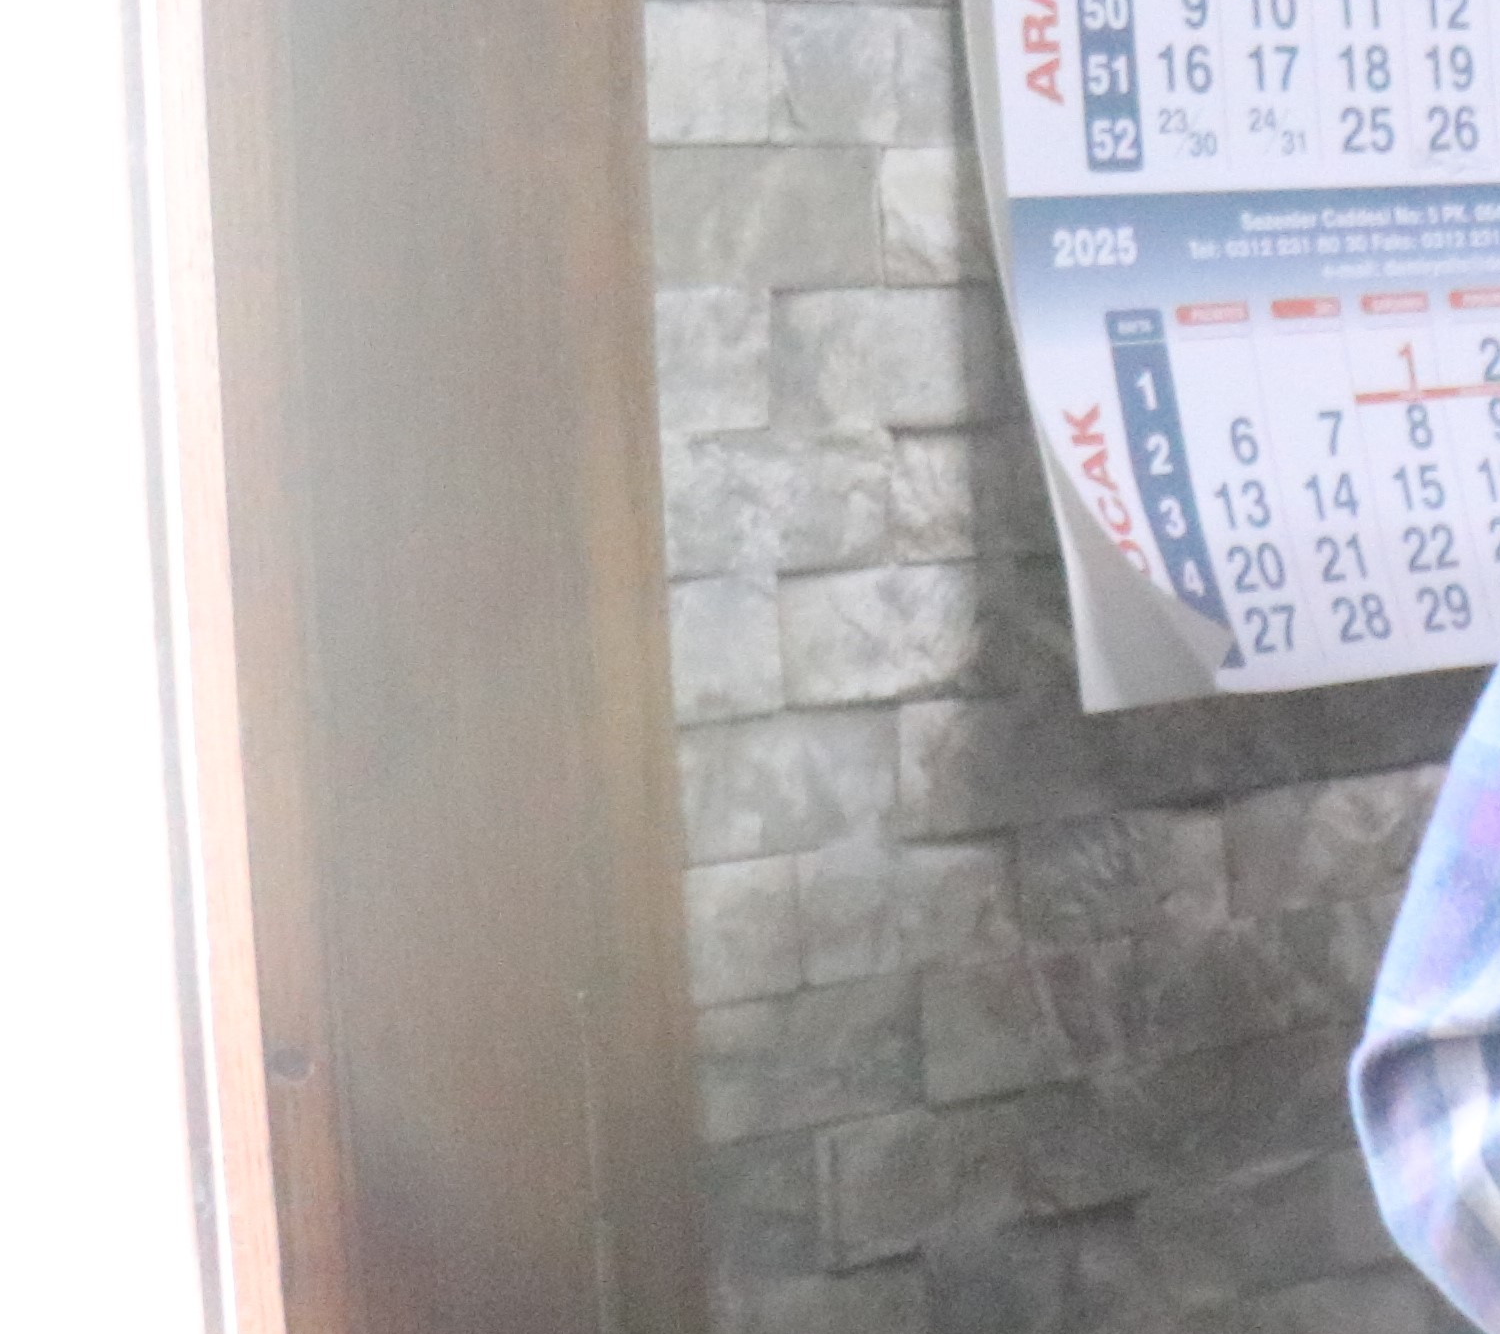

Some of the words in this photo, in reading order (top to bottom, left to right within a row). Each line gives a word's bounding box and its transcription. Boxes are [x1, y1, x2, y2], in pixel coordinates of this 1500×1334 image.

[1088, 54, 1128, 94] 51
[1158, 44, 1212, 94] 16
[1248, 45, 1298, 91] 17
[1339, 44, 1391, 92] 18
[1425, 45, 1474, 91] 19
[1092, 119, 1136, 159] 52
[1340, 106, 1394, 154] 25
[1428, 106, 1478, 153] 26
[1053, 227, 1137, 269] 2025
[1137, 371, 1157, 410] 1
[1398, 344, 1419, 386] 1
[1146, 433, 1172, 475] 2
[1230, 417, 1258, 465] 6
[1318, 410, 1342, 456] 7
[1401, 399, 1433, 449] 8
[1159, 497, 1186, 537] 3
[1215, 480, 1271, 529] 13
[1305, 473, 1359, 520] 14
[1393, 464, 1445, 510] 15
[1184, 560, 1204, 595] 4
[1227, 542, 1286, 593] 20
[1316, 534, 1367, 583] 21
[1403, 524, 1459, 573] 22
[1245, 605, 1294, 654] 27
[1332, 593, 1391, 644] 28
[1417, 583, 1471, 632] 29
